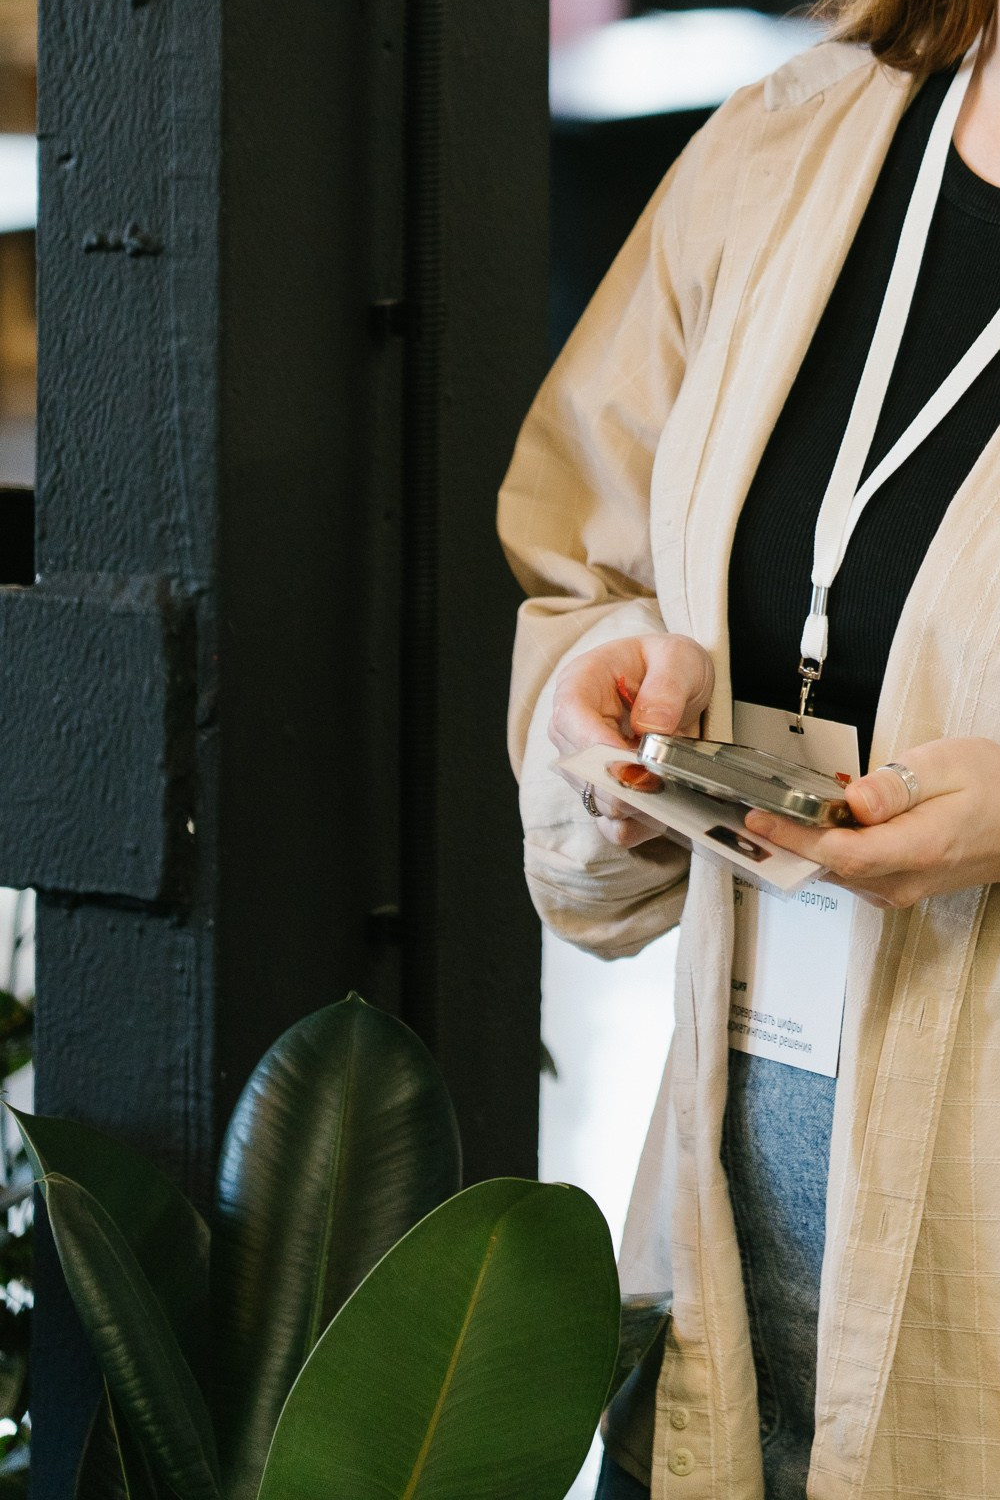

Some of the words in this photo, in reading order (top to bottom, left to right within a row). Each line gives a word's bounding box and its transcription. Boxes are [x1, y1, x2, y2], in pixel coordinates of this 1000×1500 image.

[788, 887, 838, 911] итературы
[731, 979, 747, 991] ция
[777, 1017, 803, 1035] цифры
[779, 1035, 812, 1053] решения
